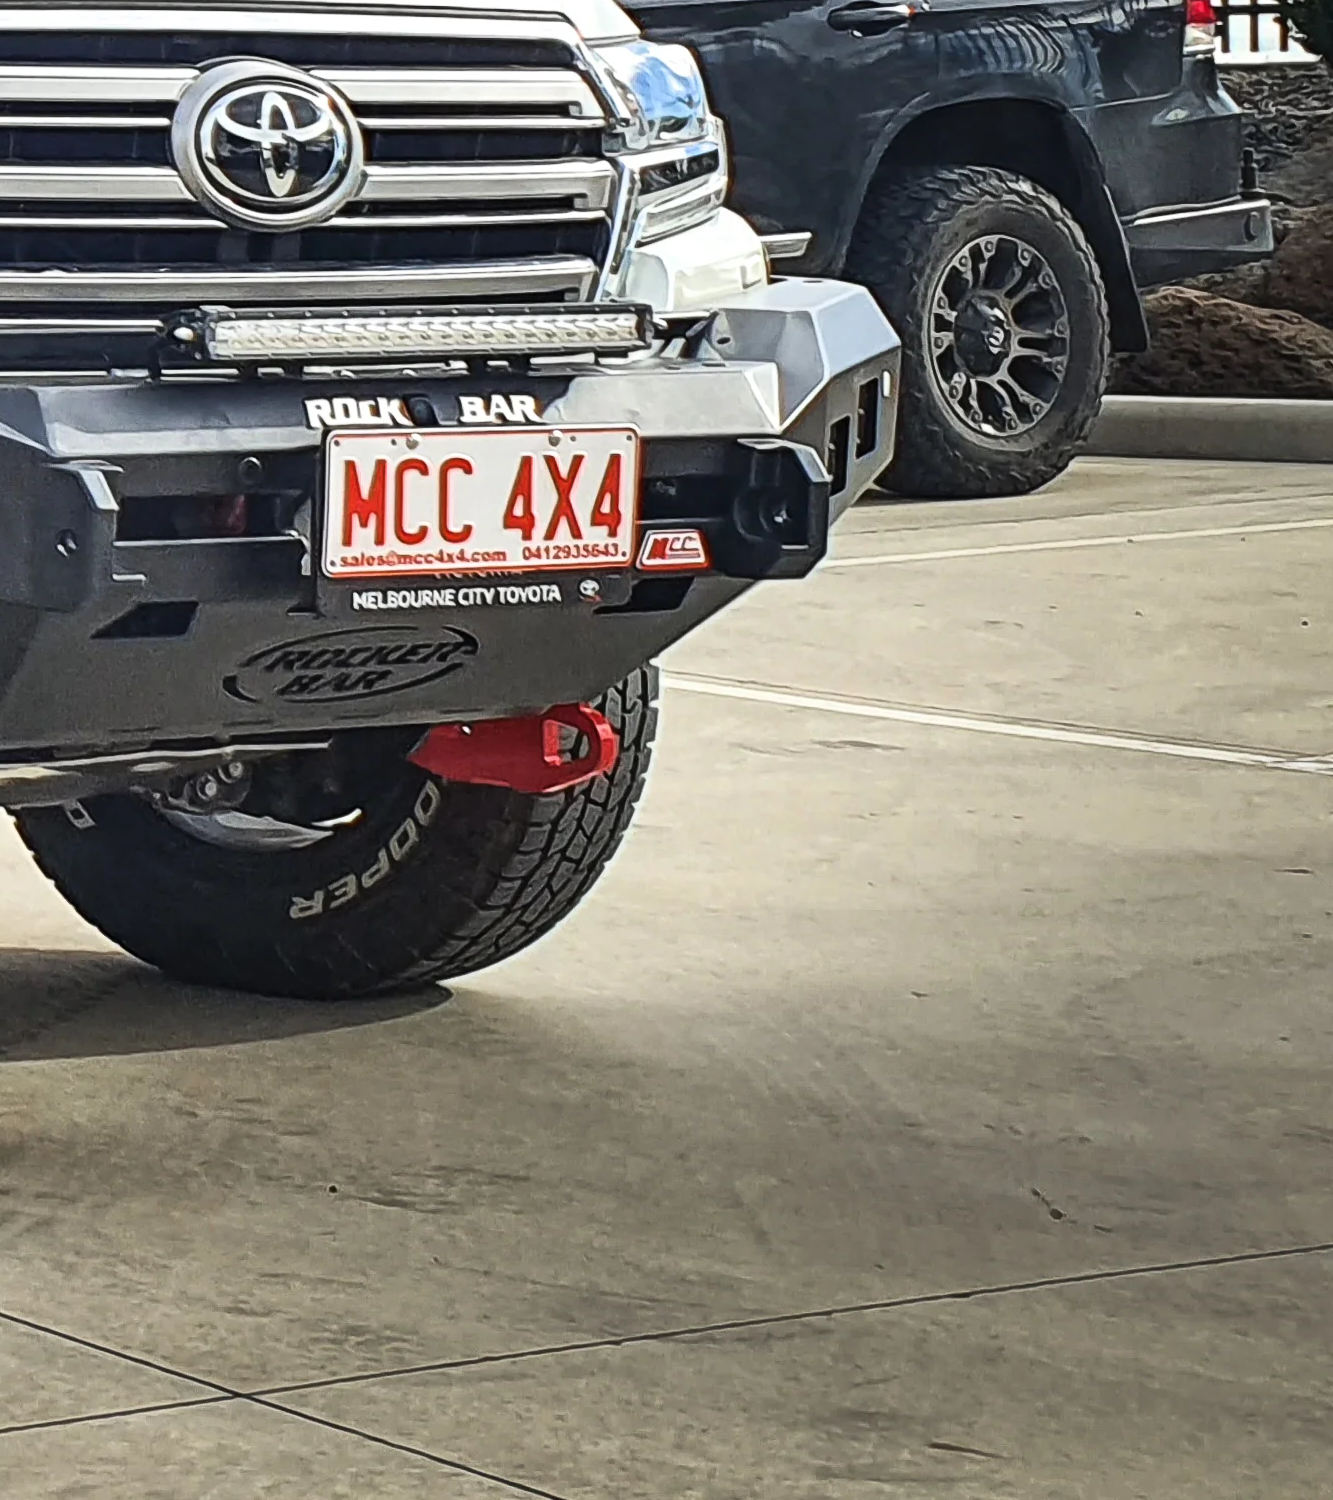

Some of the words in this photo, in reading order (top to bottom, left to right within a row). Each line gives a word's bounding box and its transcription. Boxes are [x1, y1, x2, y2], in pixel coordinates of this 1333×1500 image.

[459, 393, 551, 424] BAR
[340, 456, 476, 547] MCC
[502, 452, 623, 541] 4X4
[339, 549, 508, 568] sales@mcc4x4.com
[352, 586, 456, 610] MELBOURNE
[458, 586, 494, 606] CITY
[496, 583, 562, 605] TOYOTA
[263, 641, 476, 672] ROCKER
[273, 669, 394, 695] BAR
[289, 778, 443, 920] OOPER
